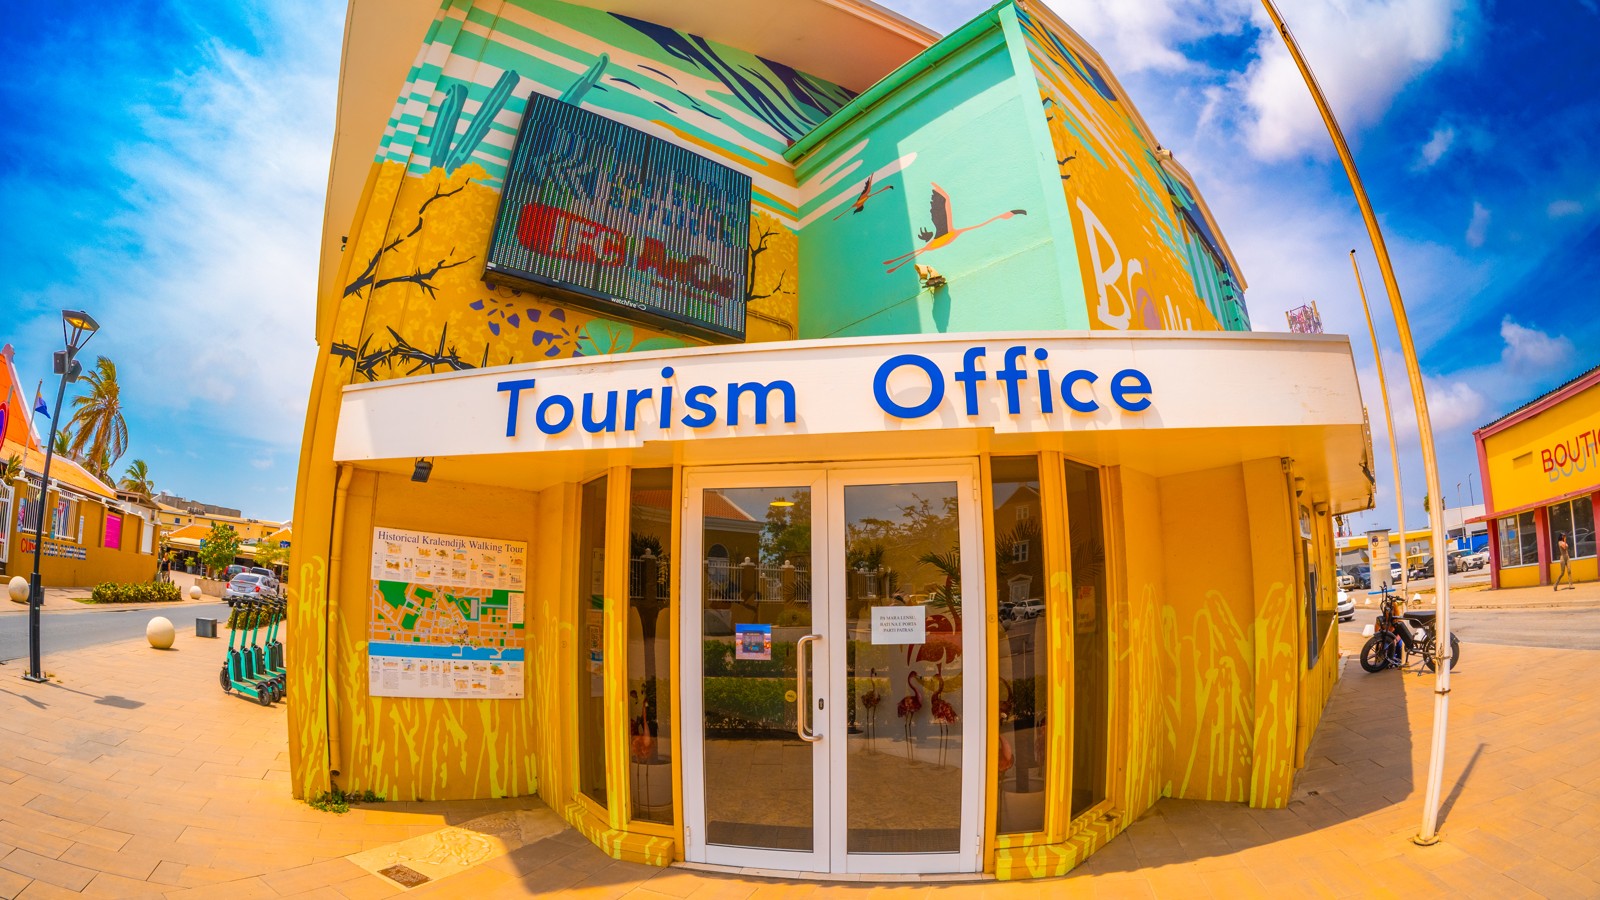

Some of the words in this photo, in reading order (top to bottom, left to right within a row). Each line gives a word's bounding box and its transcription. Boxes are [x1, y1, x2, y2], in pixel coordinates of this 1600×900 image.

[611, 297, 636, 308] watchfire
[498, 367, 795, 436] Tourism
[874, 346, 1151, 418] Office
[1541, 429, 1600, 473] BOUTI
[378, 530, 420, 544] Historical
[422, 535, 466, 550] Kralendijk
[469, 540, 503, 553] Walking
[505, 543, 524, 553] Tour
